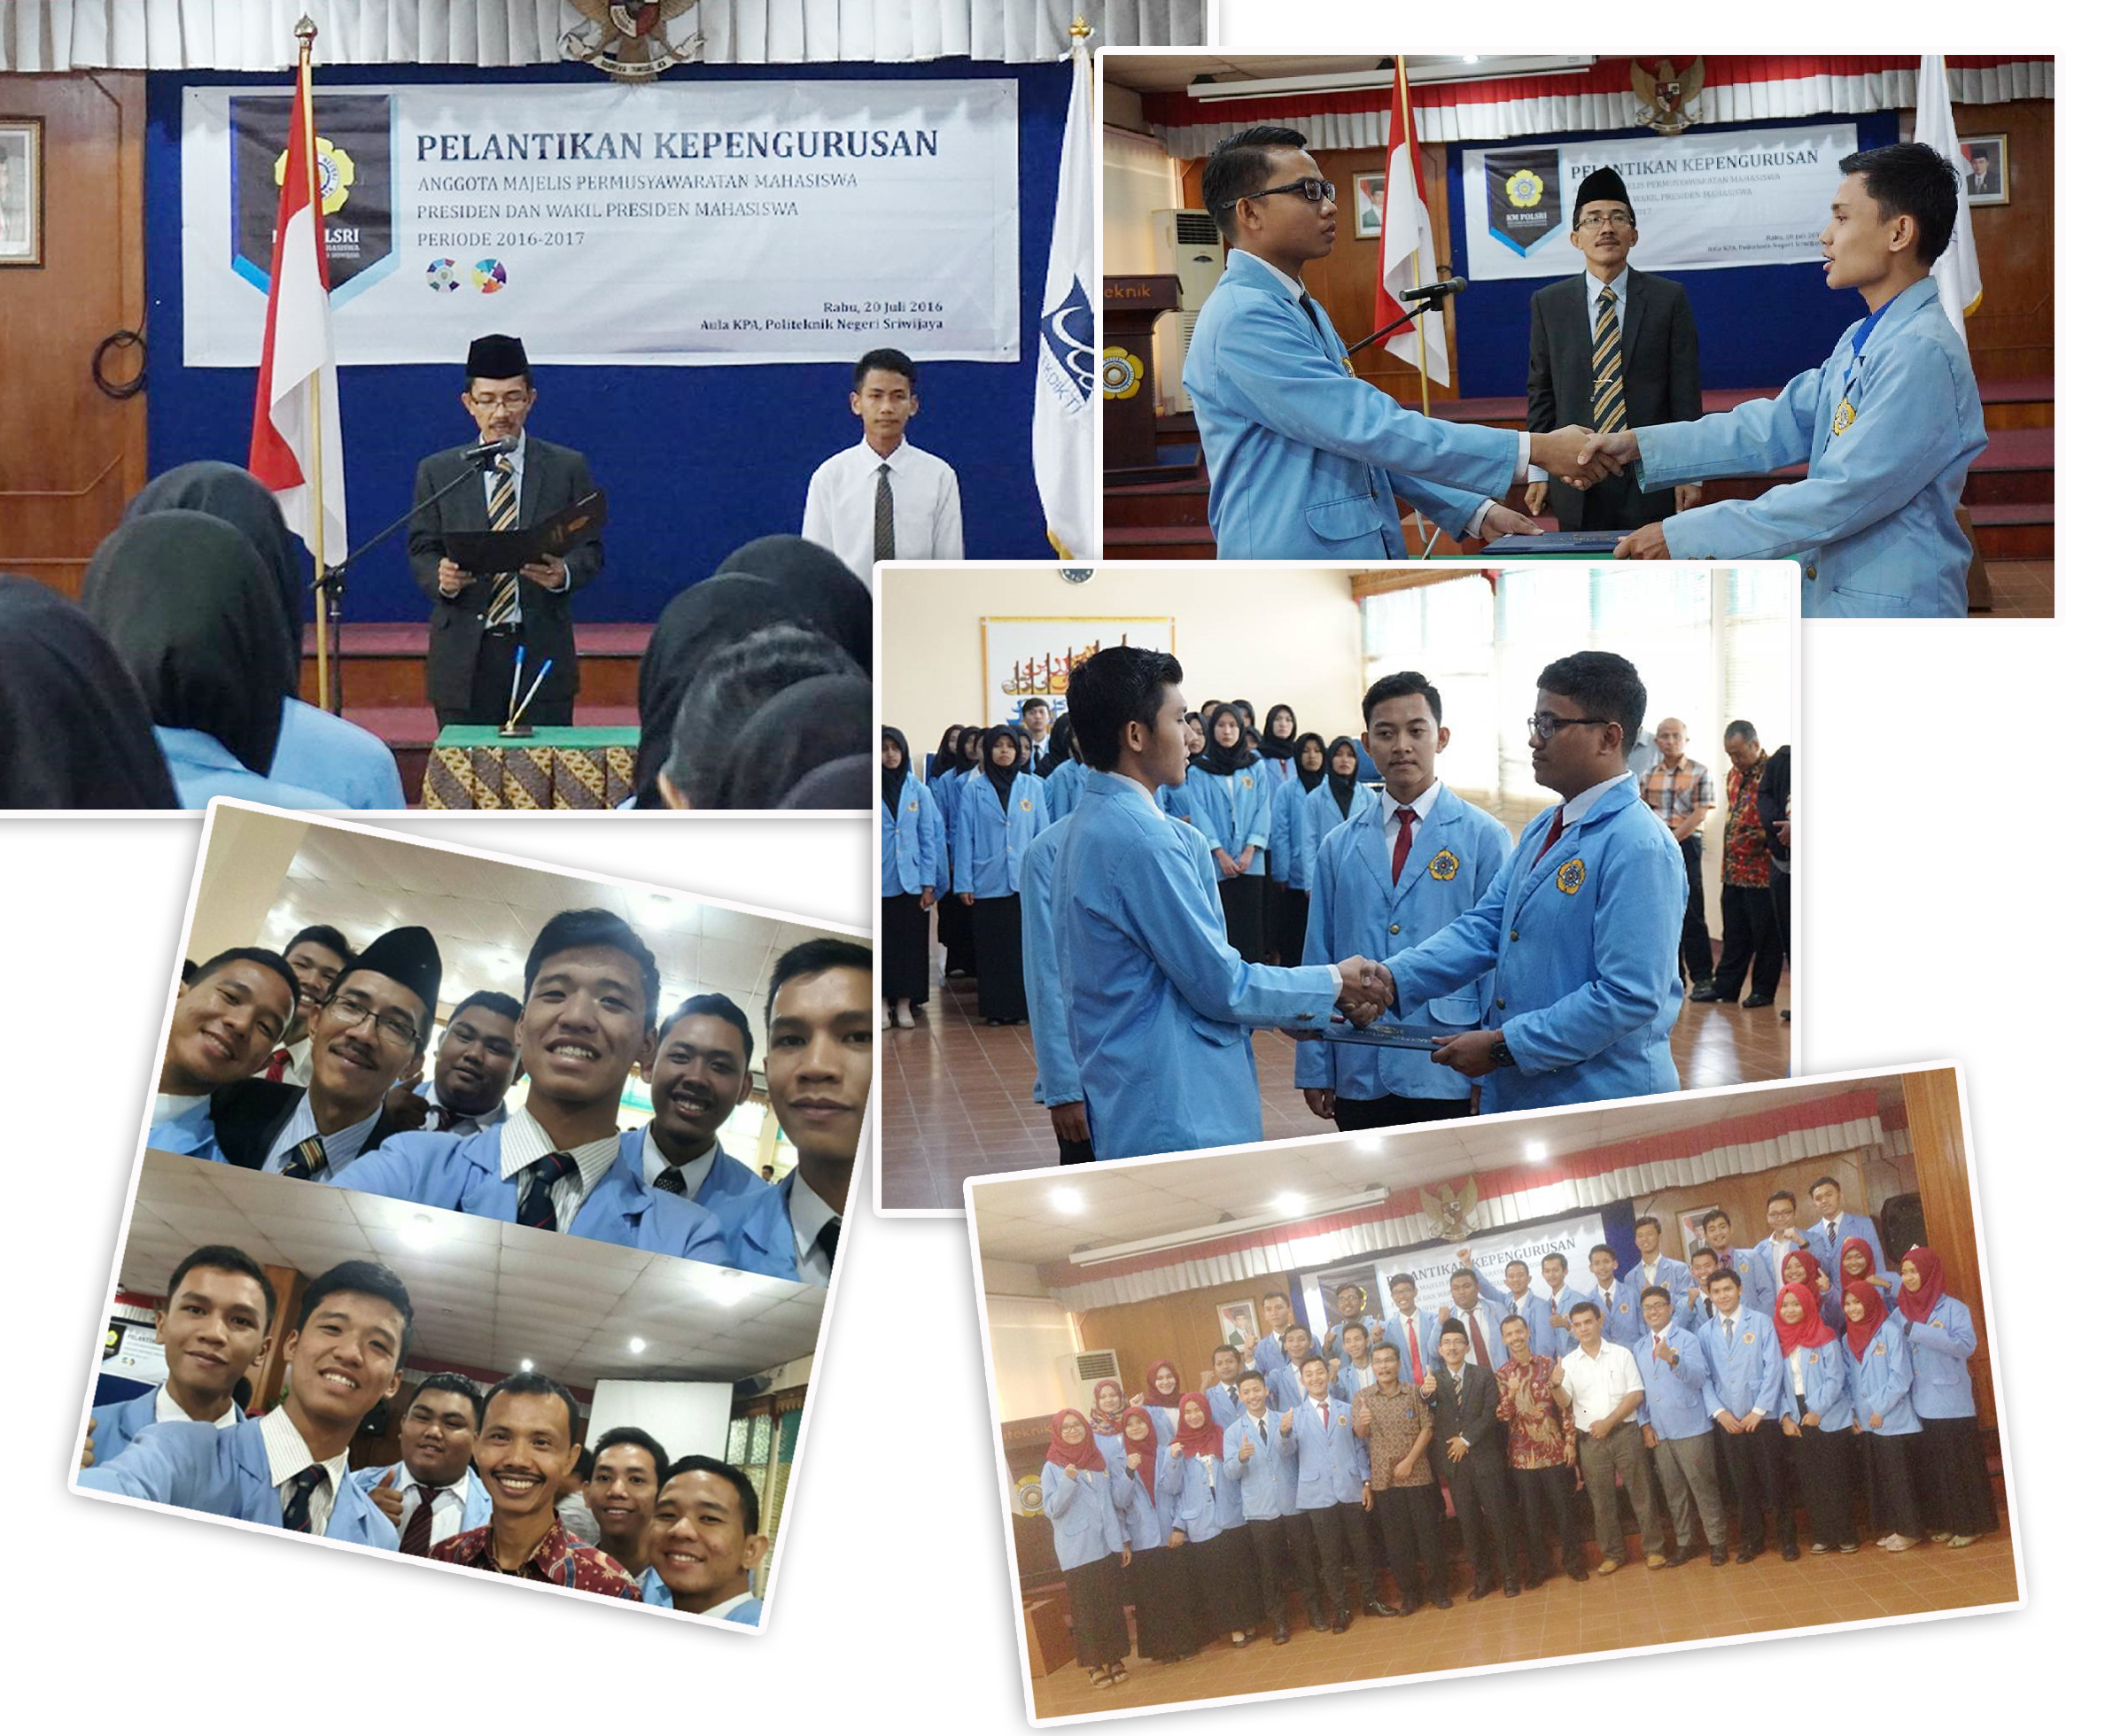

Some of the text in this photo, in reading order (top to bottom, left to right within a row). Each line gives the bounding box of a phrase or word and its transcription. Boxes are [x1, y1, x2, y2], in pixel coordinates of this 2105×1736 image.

[416, 130, 938, 161] PELANTIKAN KEPENGURUSAN
[1572, 149, 1819, 179] PENTIKAN KEPENGURUSAN
[417, 173, 858, 193] ANGGOTA MAJELIS PERMUSYAWARATAN MAHASISWA
[417, 201, 799, 219] PRESIDEN DAN WAKIL PRESIDEN MAHASISWA
[325, 228, 359, 244] LSRI
[417, 232, 585, 247] PERIODE 2016-2017
[864, 302, 881, 313] 20
[884, 301, 905, 315] Juli
[910, 301, 944, 313] 2016
[700, 320, 729, 330] Aula
[765, 319, 834, 330] Politeknik
[837, 319, 880, 332] Negeri
[883, 318, 944, 332] Sriwijaya
[1472, 1237, 1576, 1267] KEPENGURUSAN
